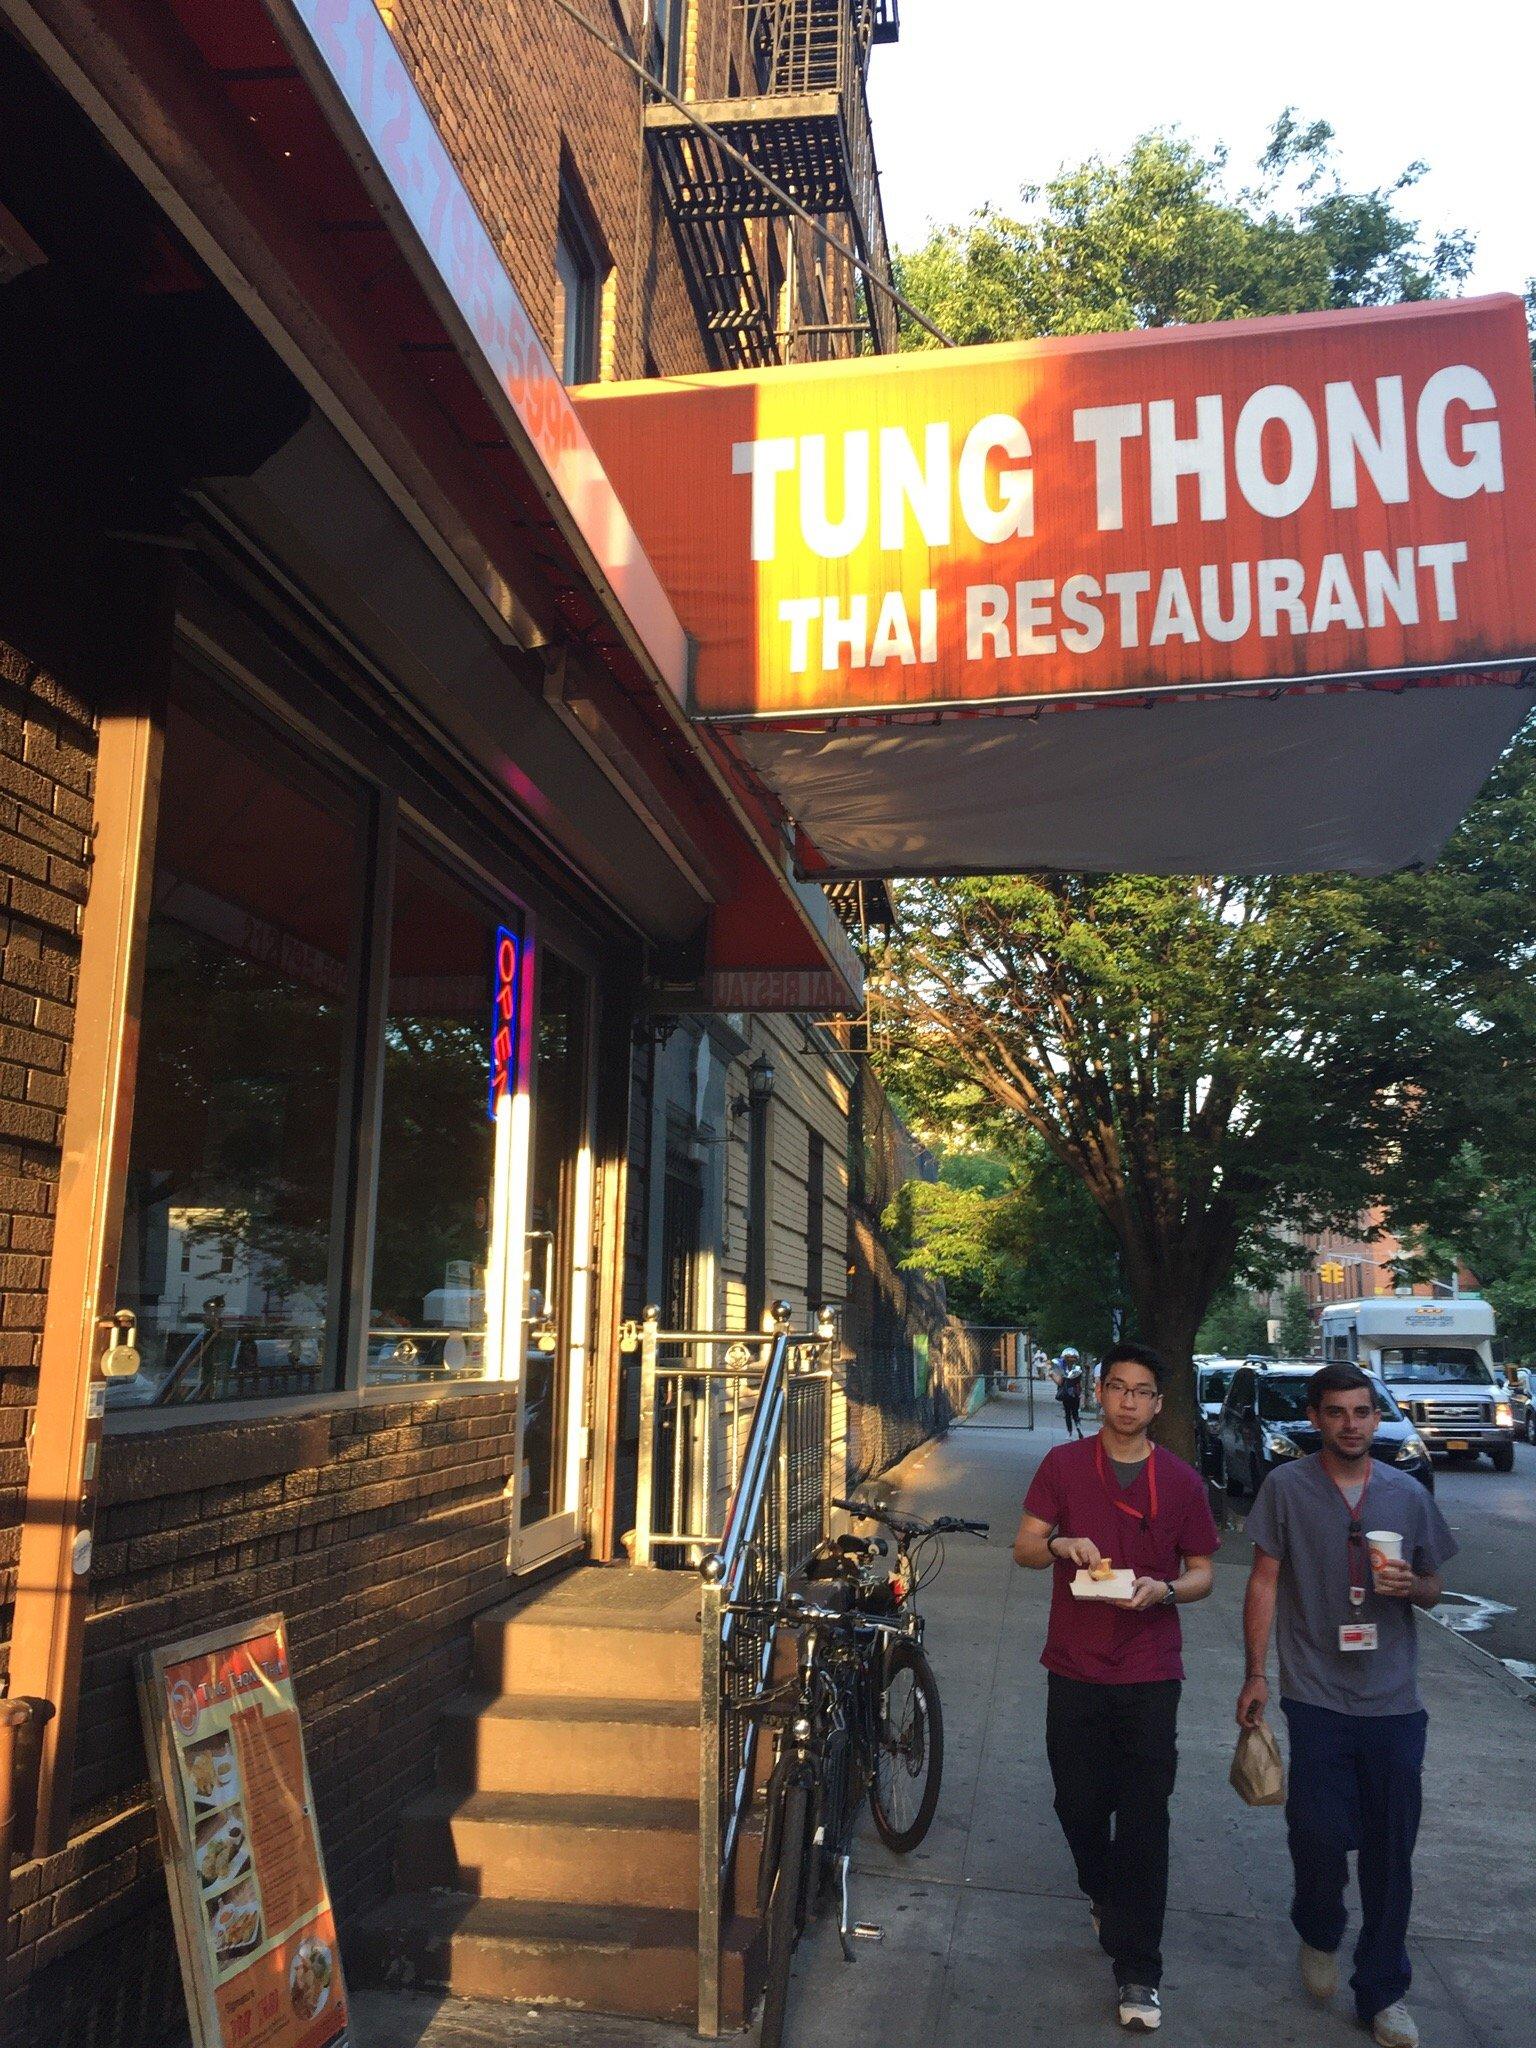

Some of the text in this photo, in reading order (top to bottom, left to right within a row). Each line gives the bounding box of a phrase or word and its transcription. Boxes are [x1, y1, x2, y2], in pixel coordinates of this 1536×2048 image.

[732, 364, 1505, 562] TUNG THONG
[779, 541, 1468, 672] THAI RESTAURANT
